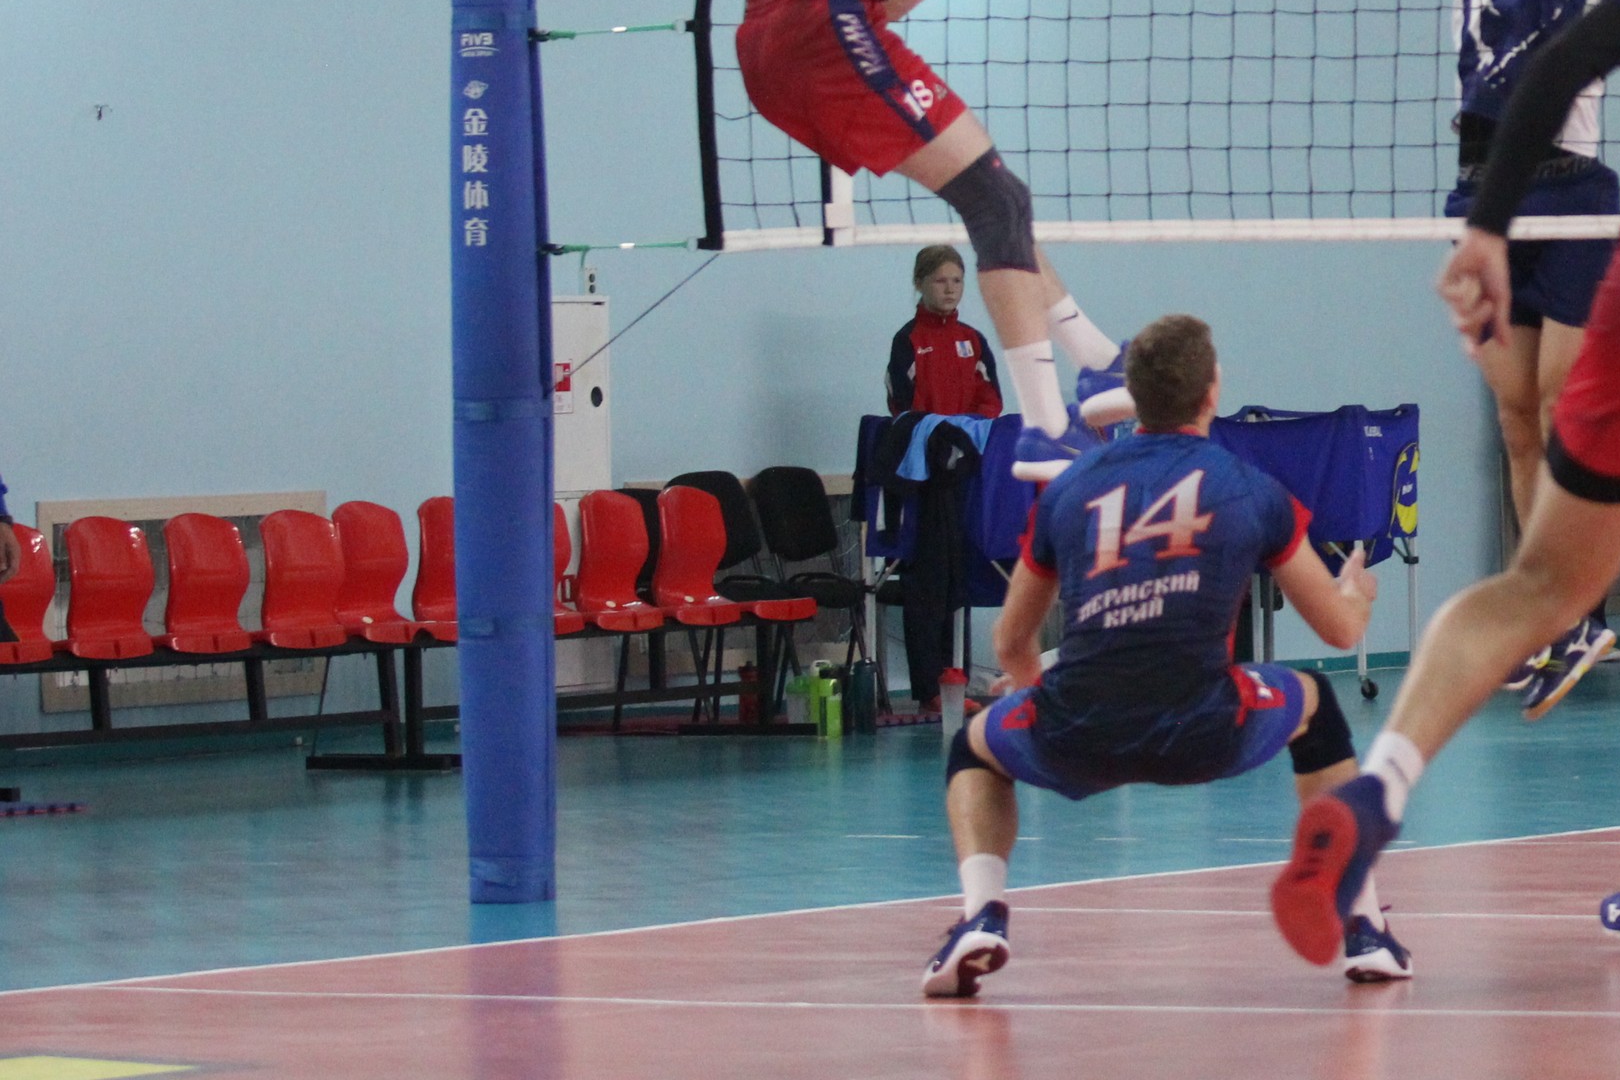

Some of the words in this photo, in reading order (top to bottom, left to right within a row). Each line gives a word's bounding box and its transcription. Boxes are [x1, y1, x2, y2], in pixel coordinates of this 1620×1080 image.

[904, 79, 934, 121] 18
[462, 107, 490, 247] 金陵体育
[1086, 468, 1216, 580] 14
[1077, 570, 1200, 623] ПЕРМСКИЙ
[1103, 597, 1164, 629] КРАЙ
